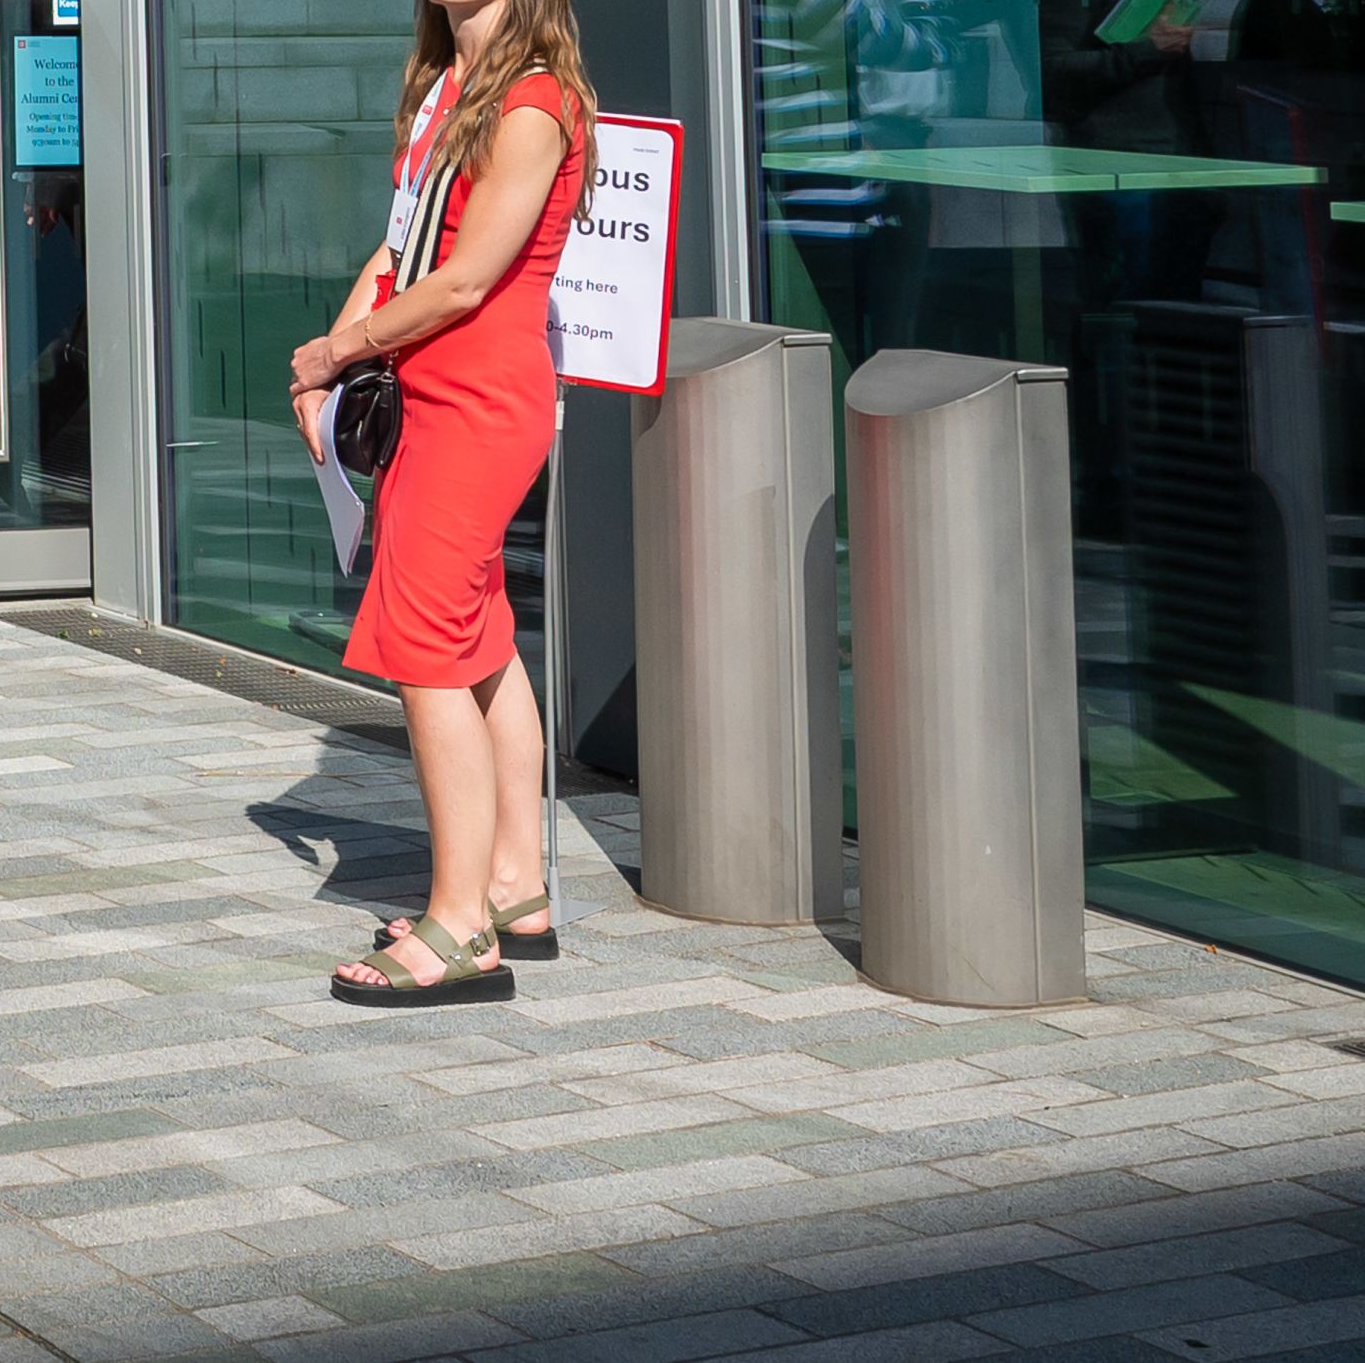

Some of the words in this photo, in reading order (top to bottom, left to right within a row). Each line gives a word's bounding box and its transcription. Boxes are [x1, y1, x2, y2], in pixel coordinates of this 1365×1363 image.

[45, 76, 56, 87] to
[58, 75, 75, 87] the
[21, 93, 59, 105] Alumni
[29, 113, 61, 122] Opening
[26, 125, 56, 134] Monday
[58, 125, 67, 134] to
[586, 279, 618, 295] here
